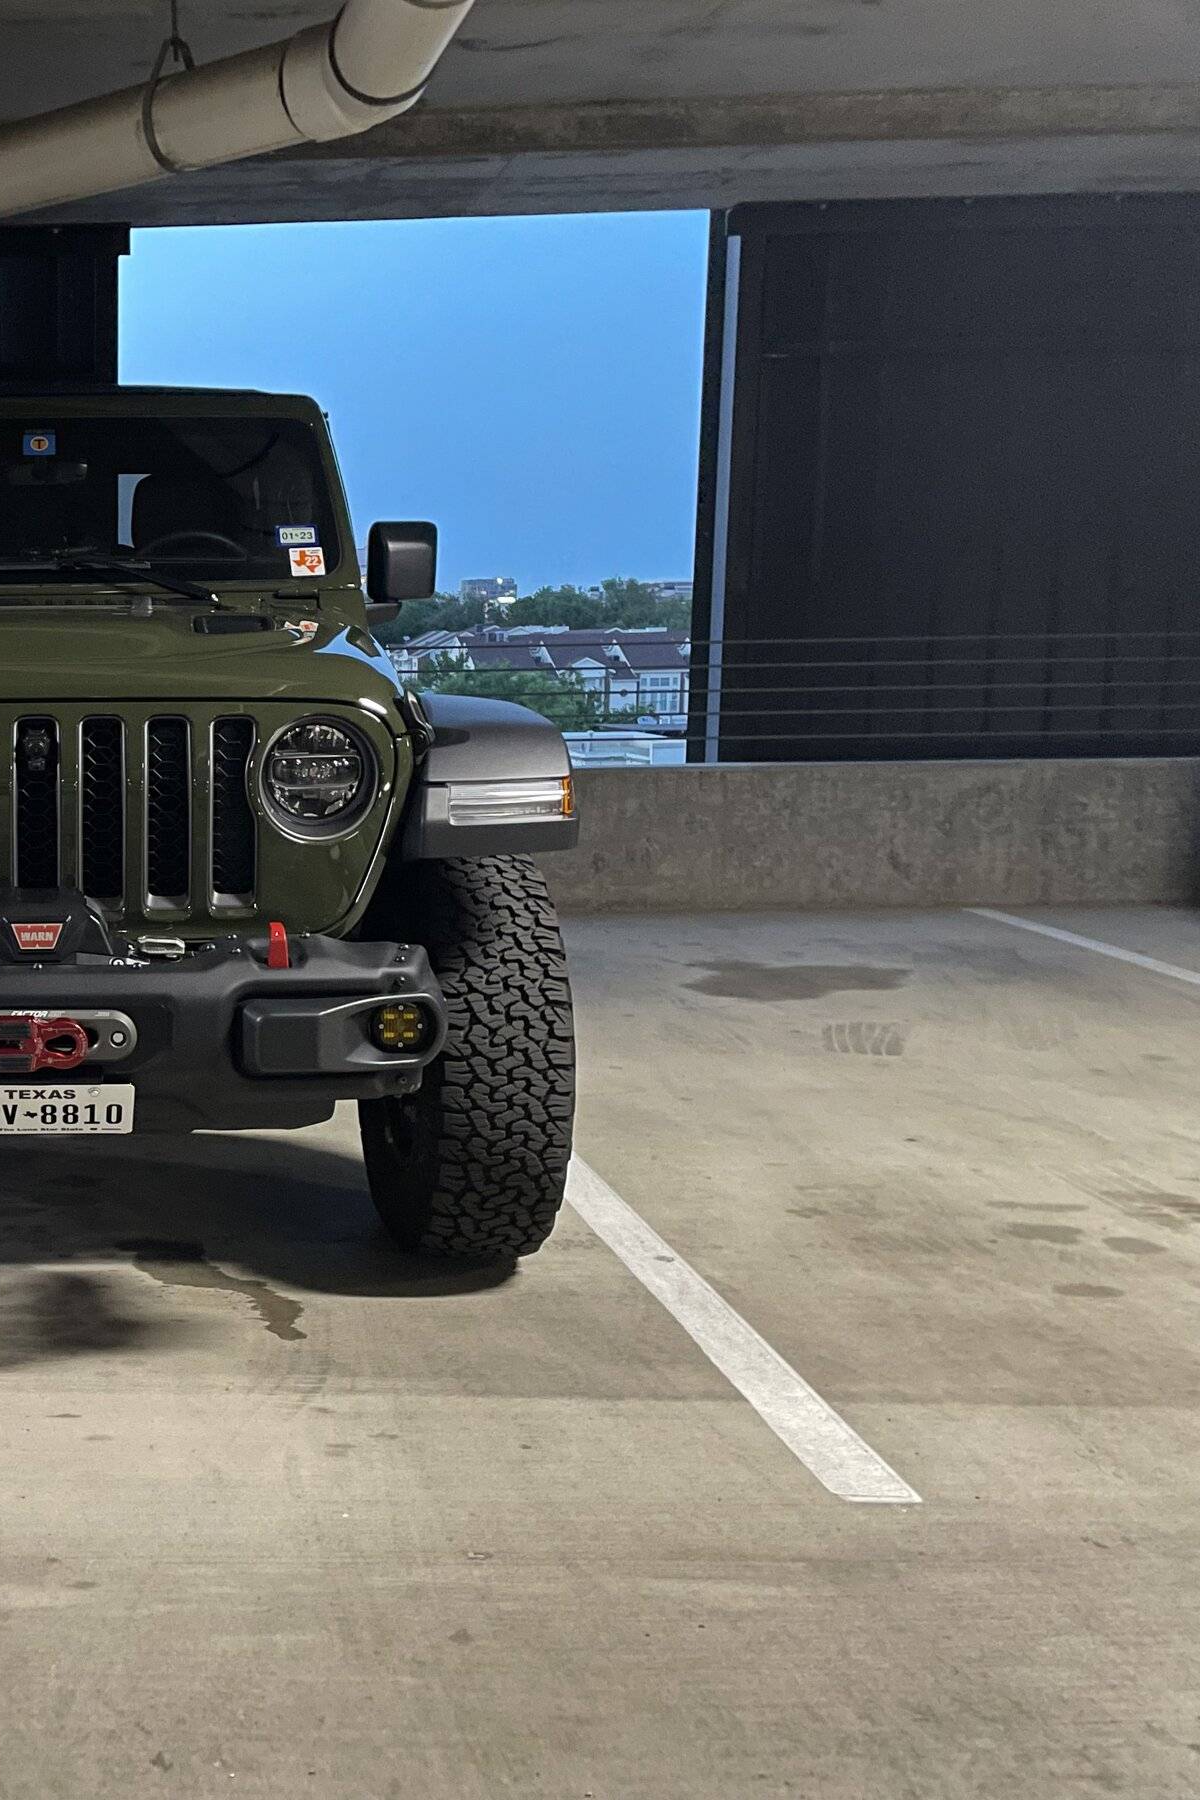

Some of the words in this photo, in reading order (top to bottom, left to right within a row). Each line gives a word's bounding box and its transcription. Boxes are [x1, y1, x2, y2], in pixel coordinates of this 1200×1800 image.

[305, 555, 319, 566] 22
[21, 931, 54, 941] WARN
[11, 1010, 48, 1018] FACTOR
[4, 1089, 76, 1100] TEXAS
